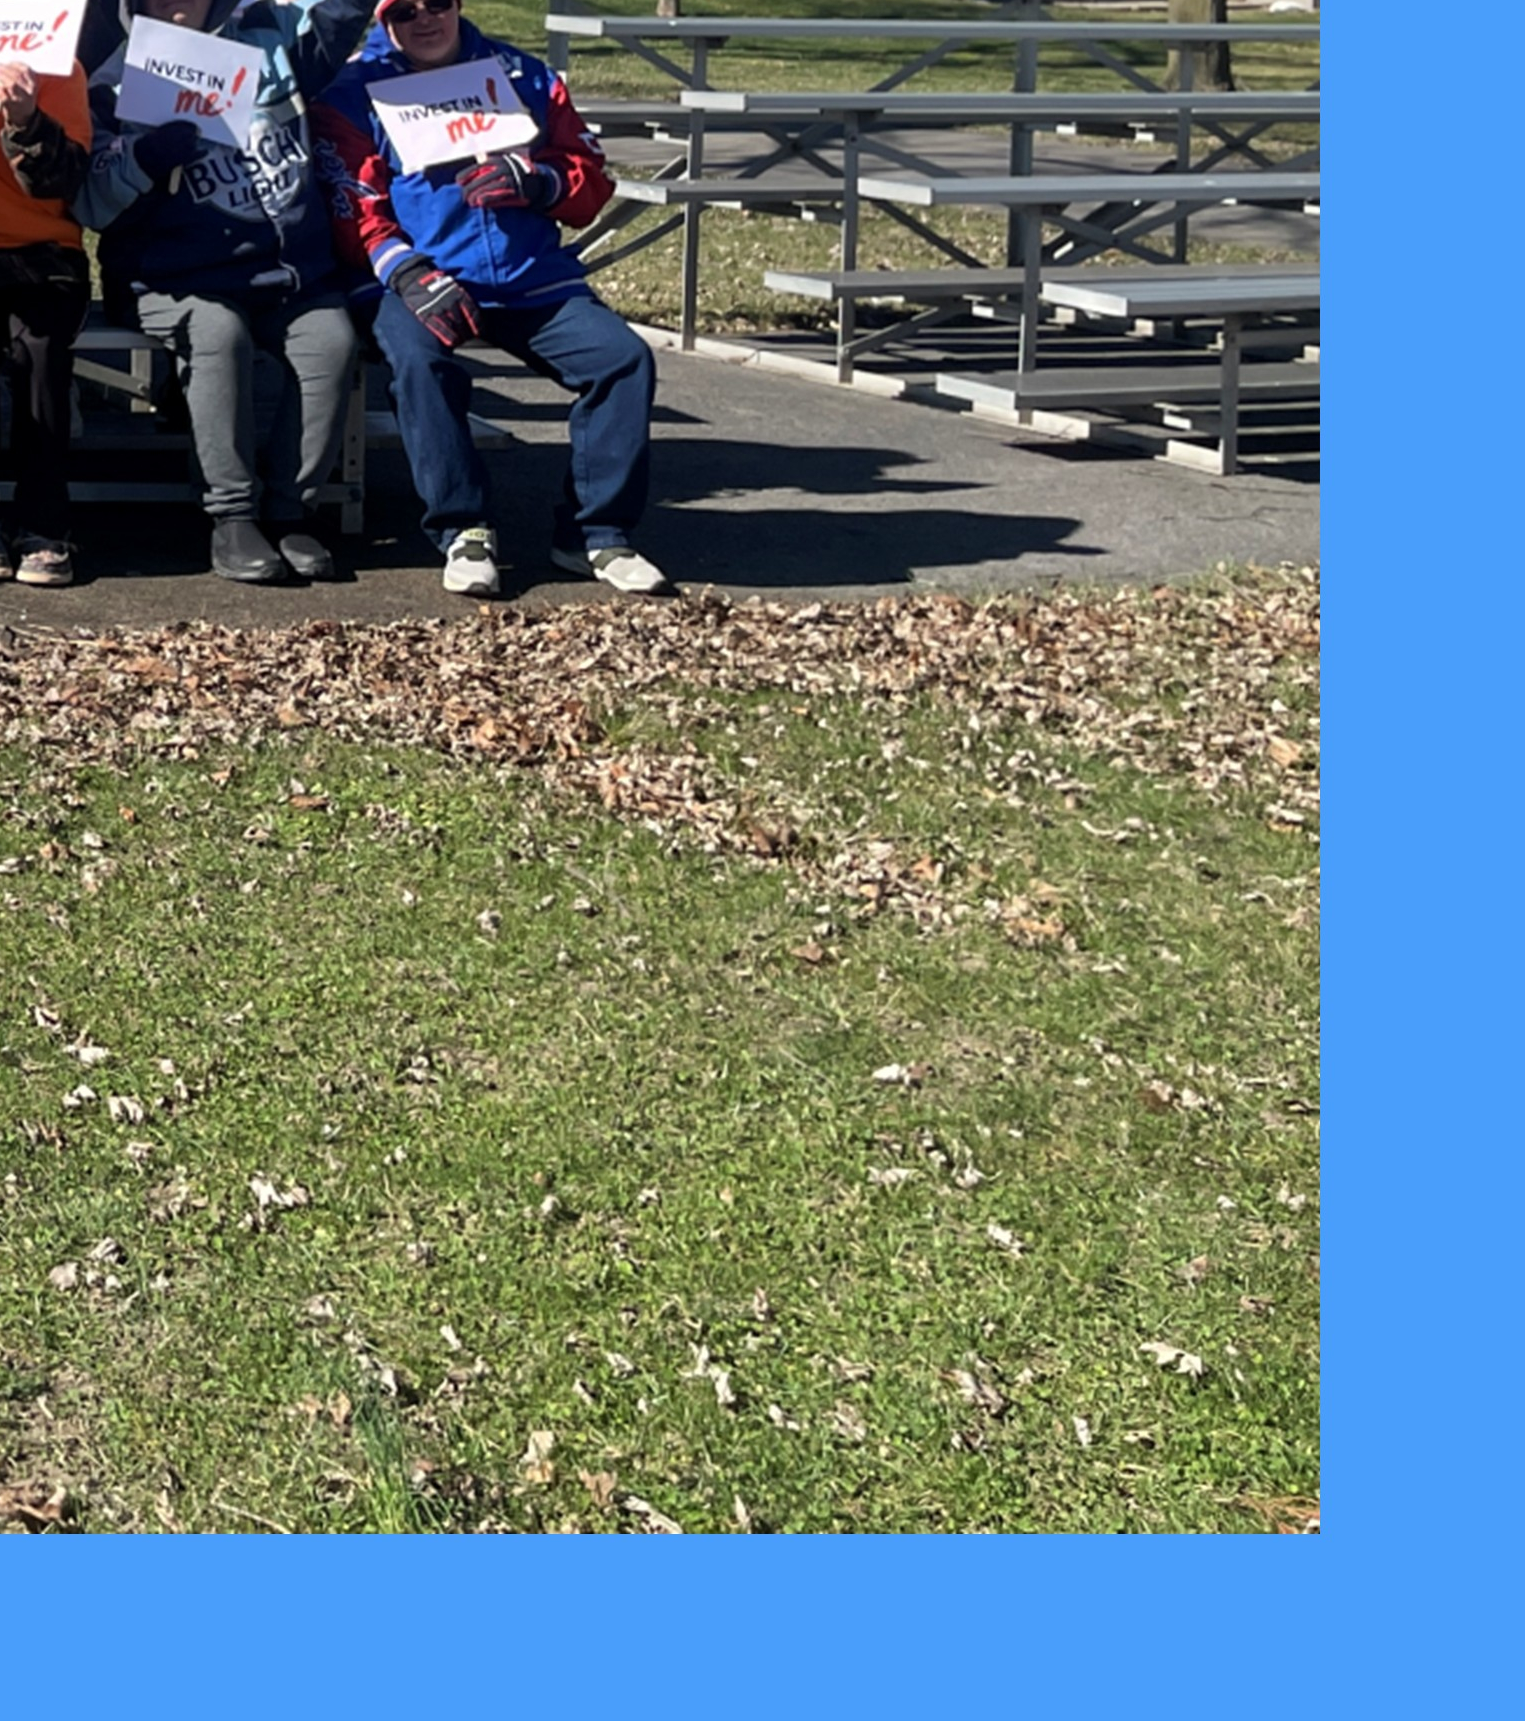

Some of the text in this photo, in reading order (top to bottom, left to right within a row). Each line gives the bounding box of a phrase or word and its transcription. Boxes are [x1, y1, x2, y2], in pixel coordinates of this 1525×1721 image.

[25, 21, 44, 31] IN
[144, 57, 226, 91] INVEST IN
[173, 66, 247, 117] me!
[400, 95, 482, 123] INVEST IN
[446, 77, 501, 144] me!
[185, 127, 302, 200] BUSCH
